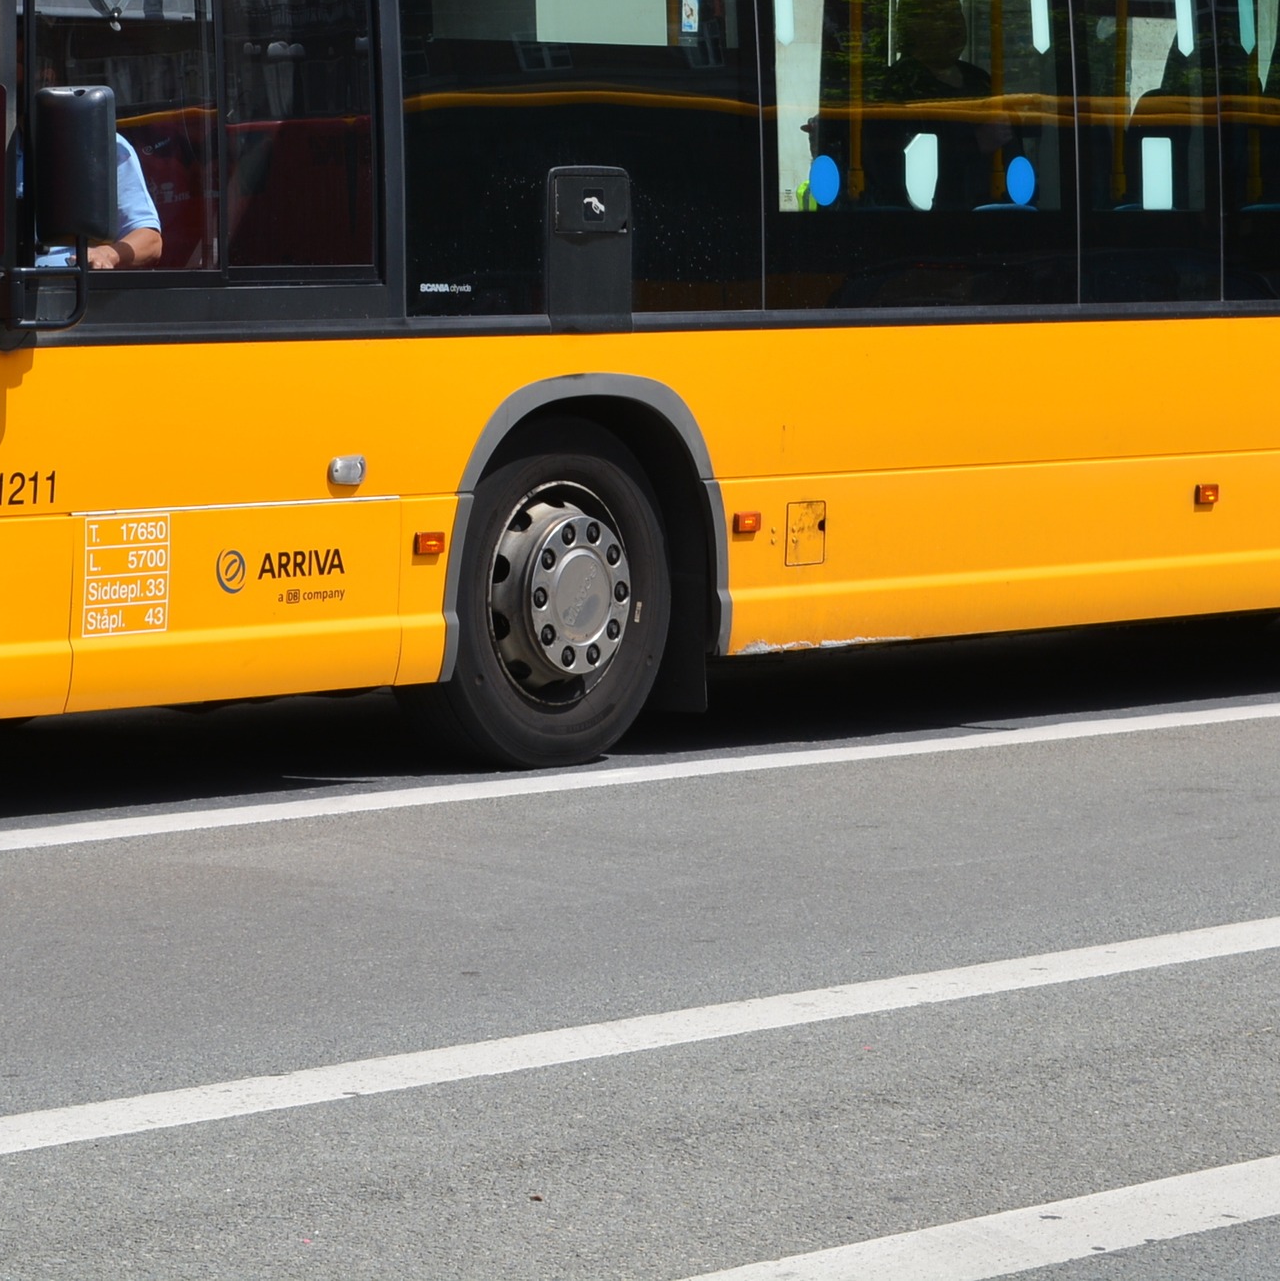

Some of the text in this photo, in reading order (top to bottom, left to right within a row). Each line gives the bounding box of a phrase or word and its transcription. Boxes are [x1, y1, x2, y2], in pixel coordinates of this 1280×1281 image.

[420, 283, 472, 294] SCANIA citywide
[88, 521, 166, 543] T. 17650
[89, 549, 166, 572] L. 5700
[257, 548, 346, 581] ARRIVA
[88, 578, 165, 603] Siddepl. 33
[278, 589, 346, 602] a DB company
[86, 607, 164, 633] Ståpl. 43
